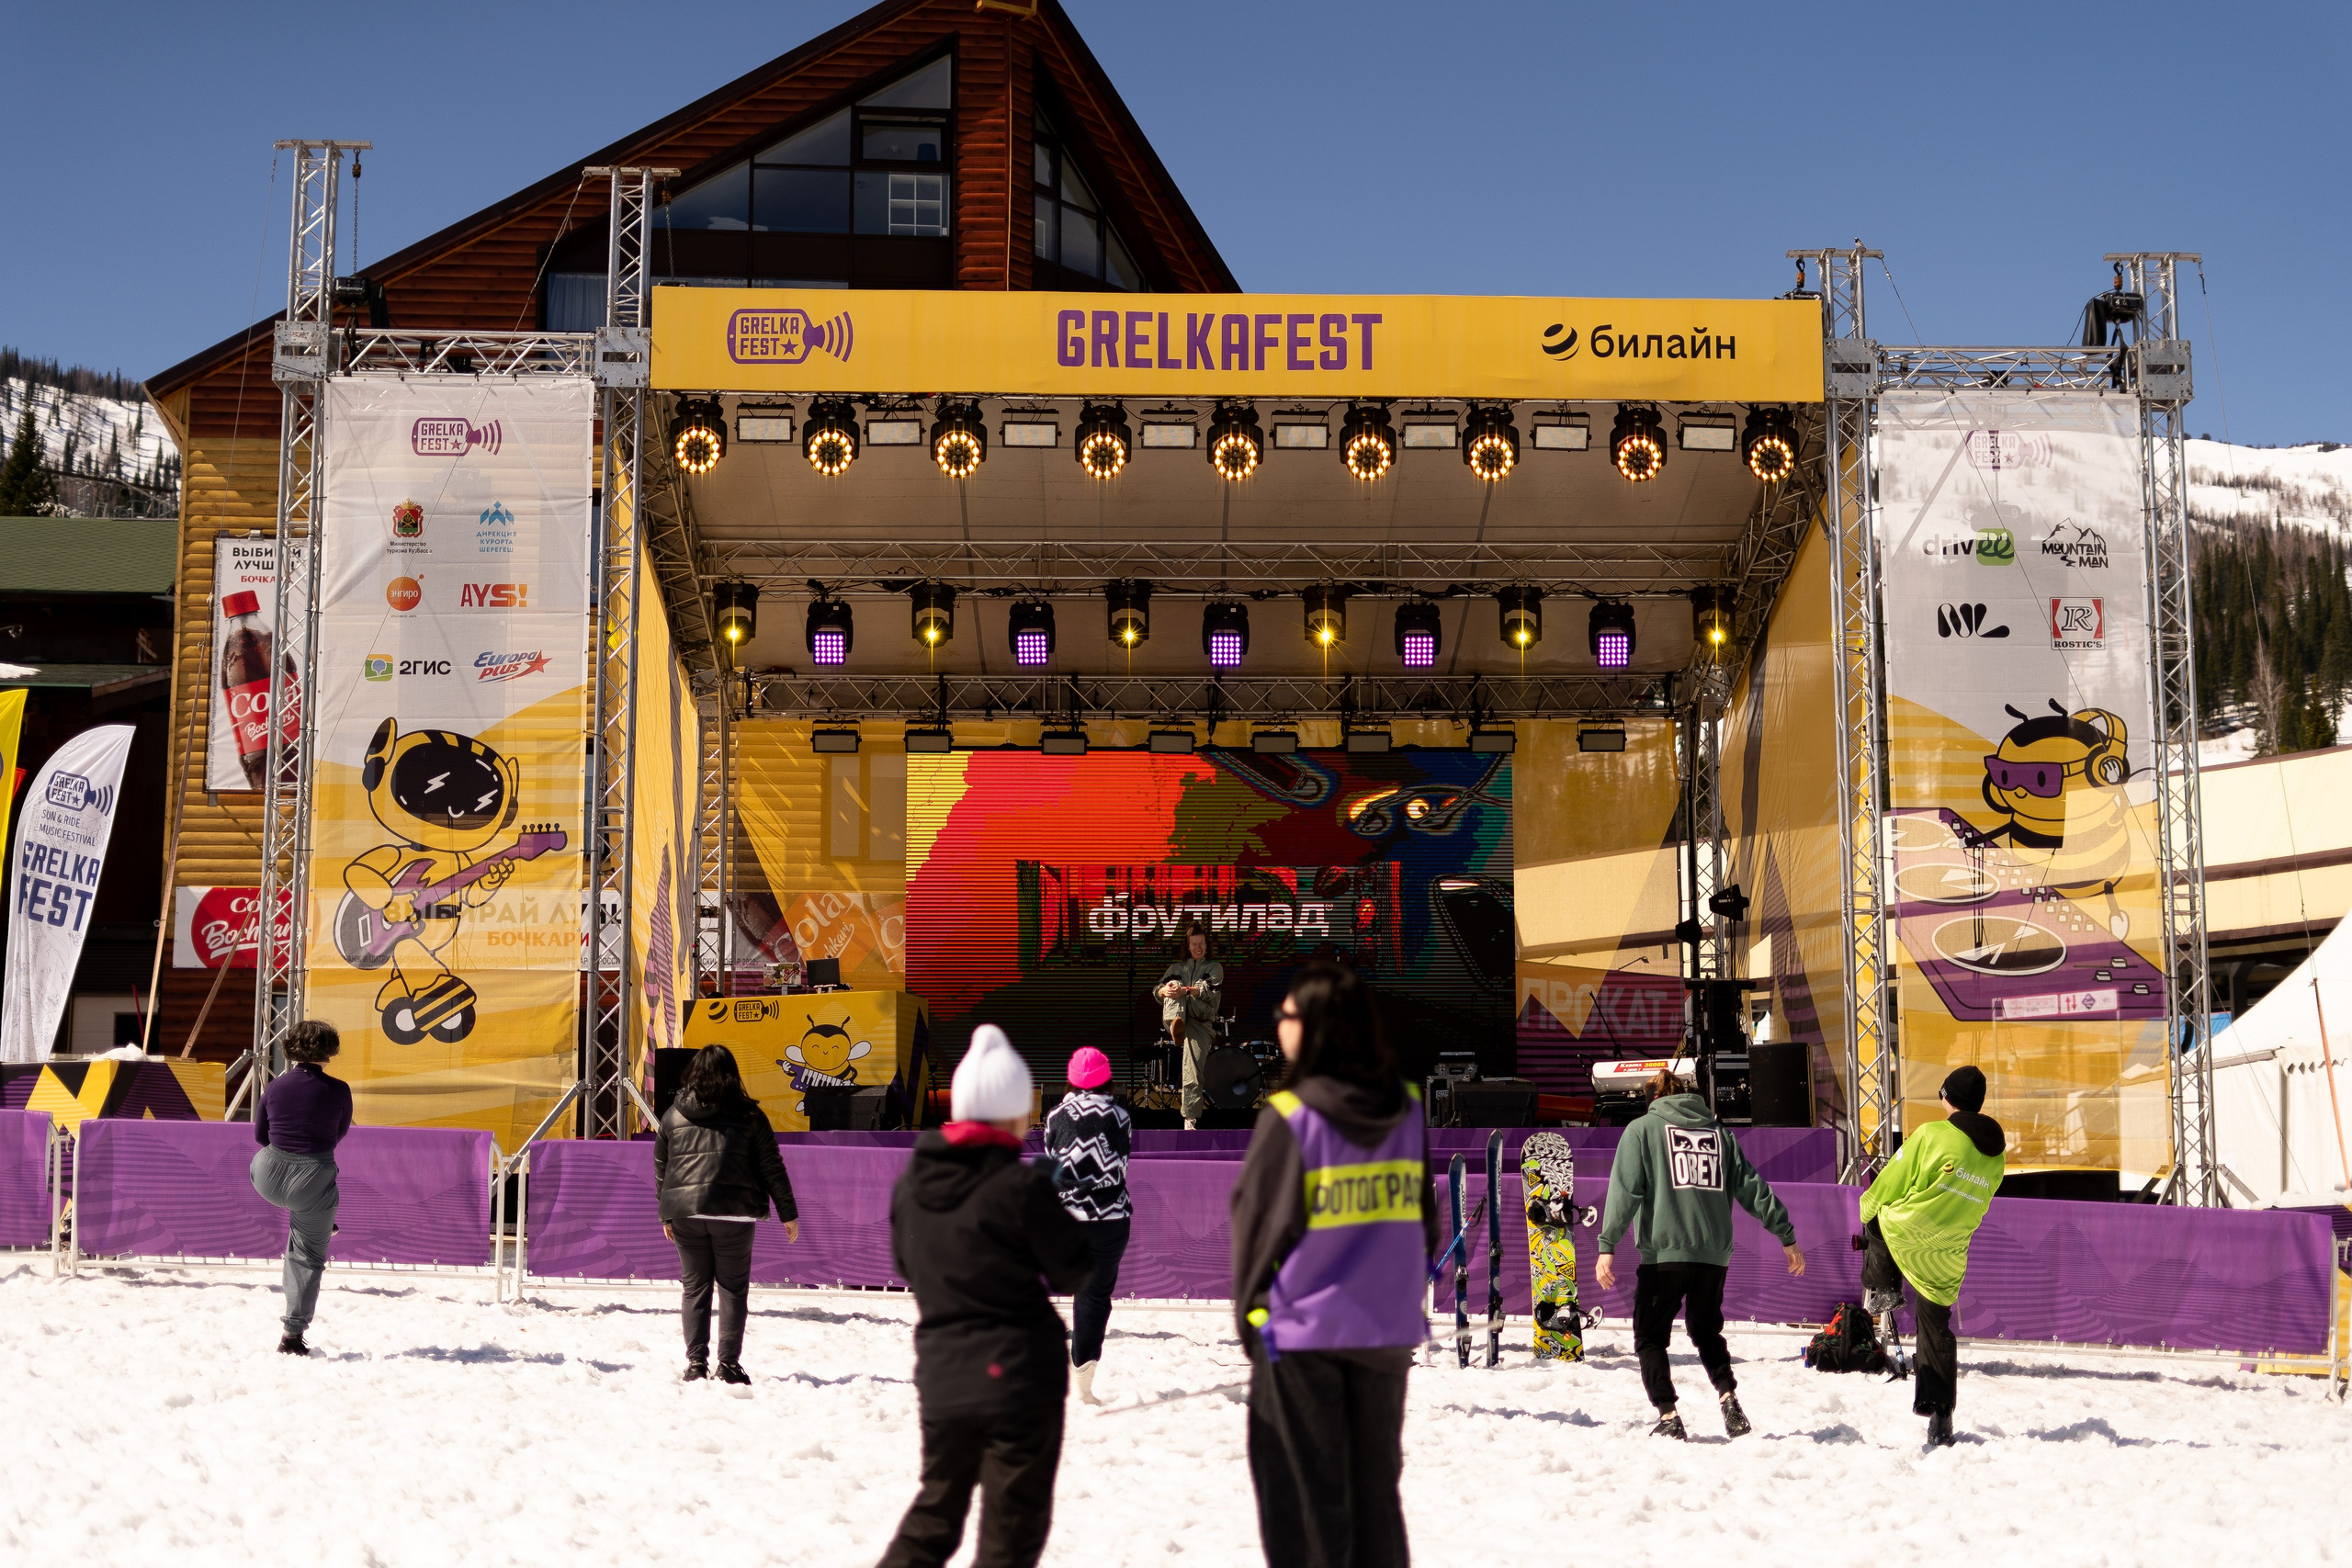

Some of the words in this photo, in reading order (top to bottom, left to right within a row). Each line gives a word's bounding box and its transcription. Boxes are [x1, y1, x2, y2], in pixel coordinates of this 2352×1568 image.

[741, 316, 799, 335] GRELKA
[740, 337, 780, 355] FEST
[1057, 309, 1383, 371] GRELKAFEST
[1590, 324, 1736, 360] билайн
[421, 423, 464, 436] GRELKA
[420, 437, 450, 451] FEST
[1974, 435, 2016, 449] GRELKA
[1922, 533, 2015, 559] drivee
[2041, 542, 2108, 557] MOUNTAIN
[2078, 556, 2109, 569] MAN
[390, 590, 419, 600] энгиро
[460, 583, 528, 608] AYS!
[2061, 605, 2094, 632] R
[2053, 640, 2103, 649] ROSTIC'S
[400, 660, 451, 675] 2ГИС
[231, 686, 299, 718] Coa
[53, 775, 85, 794] GRELKA
[51, 787, 74, 804] FEST
[41, 809, 56, 822] SUN
[56, 813, 62, 824] &
[63, 815, 81, 829] RIDE
[39, 824, 62, 838] MUSIC
[62, 829, 96, 847] FESTIVAL
[17, 873, 94, 932] FEST
[487, 931, 590, 947] БОЧКАРИ
[738, 1002, 761, 1011] GRELKA
[738, 1011, 753, 1020] FEST
[1521, 976, 1668, 1039] ПРОКАТ
[1674, 1152, 1718, 1187] OBEY
[1955, 1167, 1991, 1190] билайн
